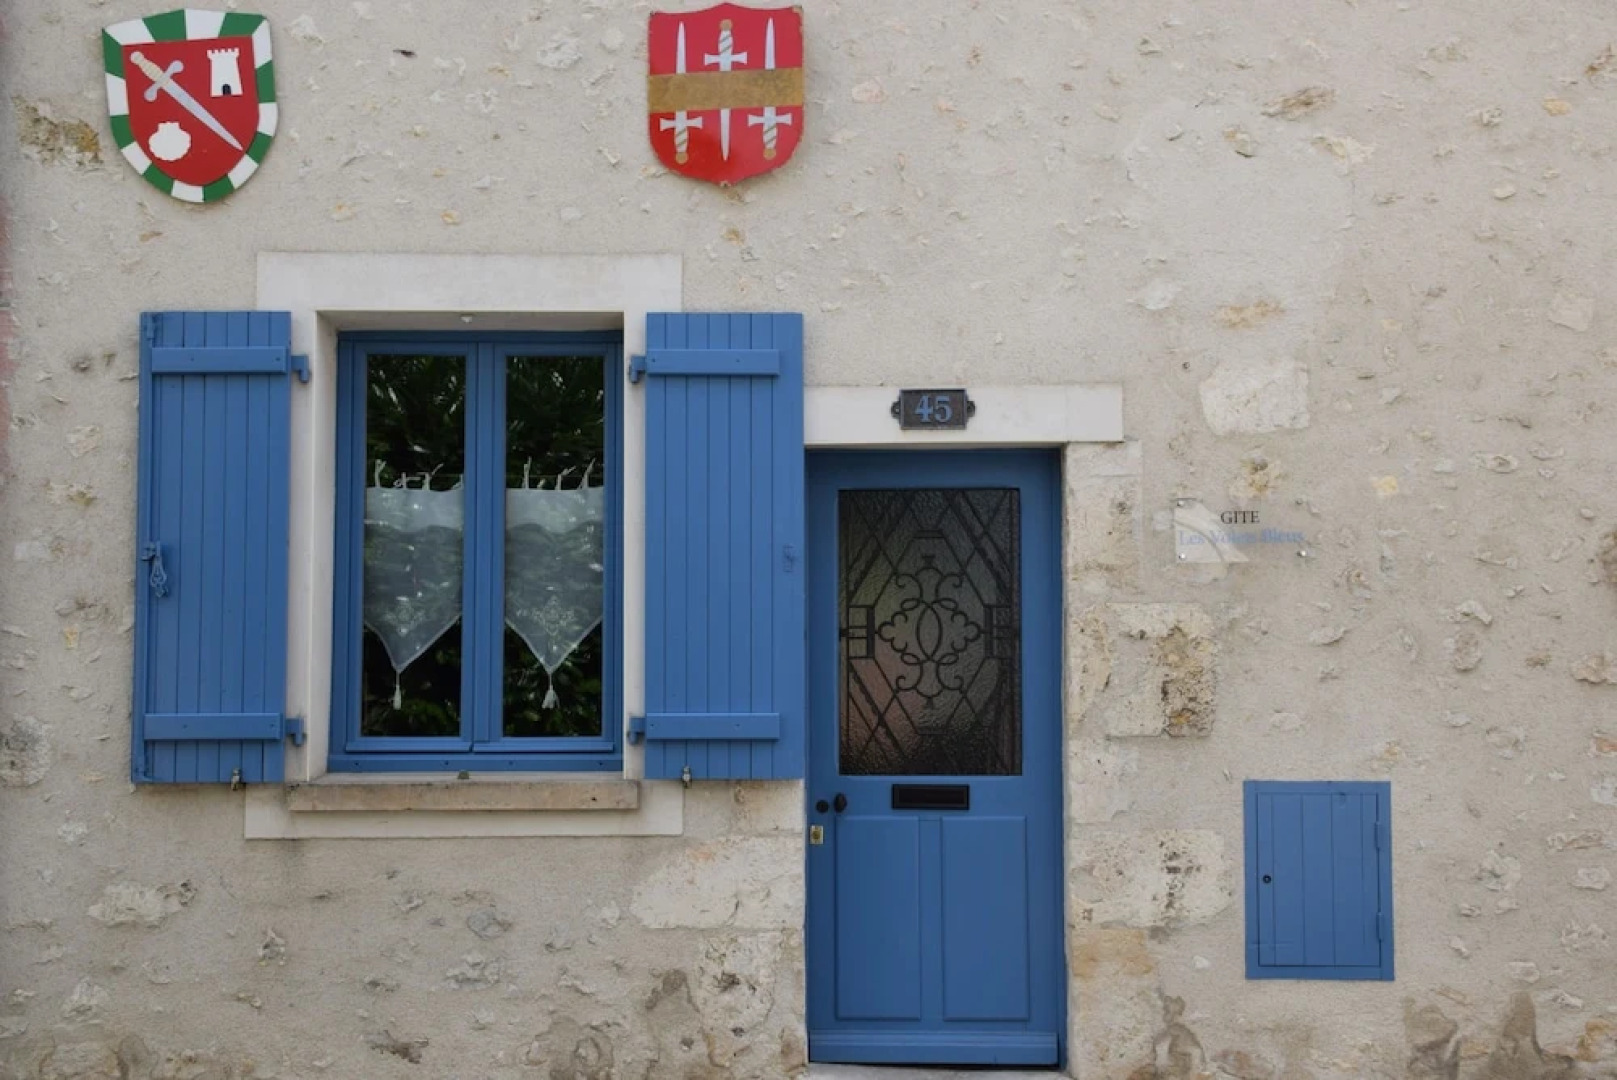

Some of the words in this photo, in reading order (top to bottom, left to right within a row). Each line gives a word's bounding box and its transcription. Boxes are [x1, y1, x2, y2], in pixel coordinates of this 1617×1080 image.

[914, 395, 953, 423] 45
[1220, 510, 1260, 525] GITE
[1179, 530, 1205, 545] Les
